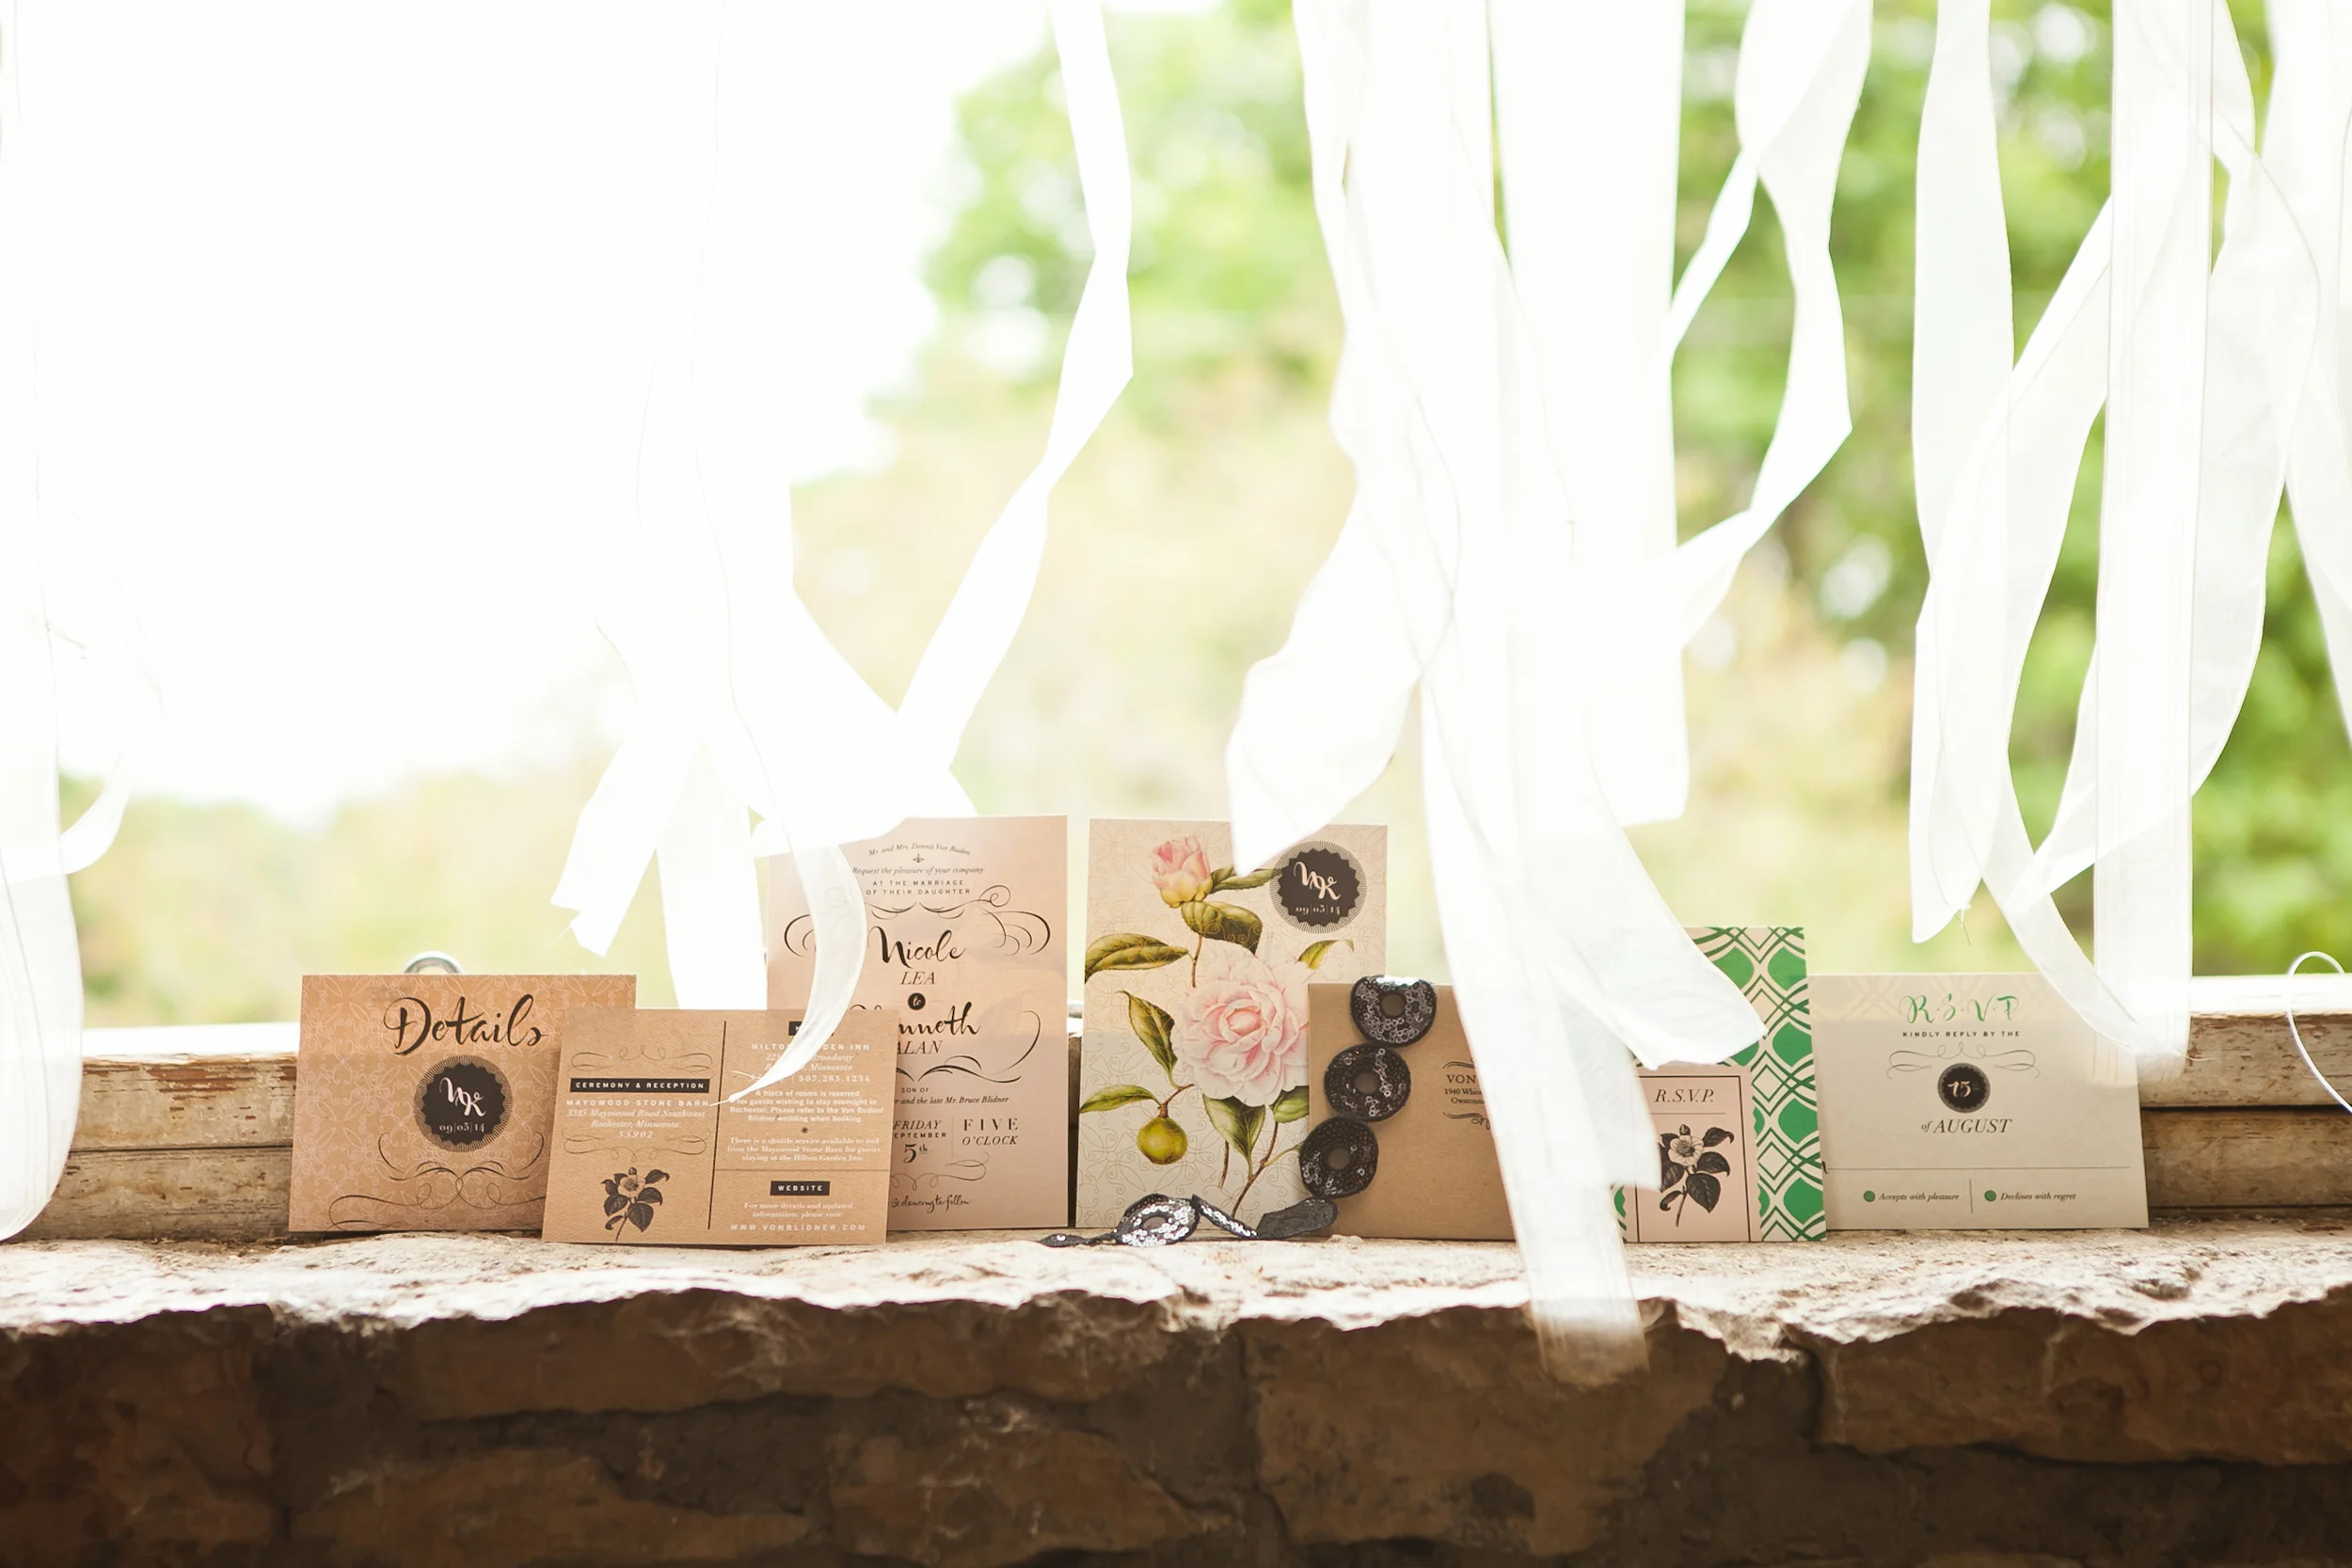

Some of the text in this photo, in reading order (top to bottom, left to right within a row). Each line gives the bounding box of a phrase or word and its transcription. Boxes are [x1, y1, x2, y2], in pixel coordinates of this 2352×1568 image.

[853, 867, 984, 875] Request the pleasure of your company
[867, 926, 966, 969] Nicole
[900, 972, 936, 985] LEA
[898, 1002, 981, 1035] nneth
[383, 994, 549, 1055] Details
[1446, 1074, 1476, 1084] VON
[1654, 1089, 1714, 1103] R.S.V.P.
[589, 1110, 635, 1119] Mayowood
[893, 1120, 941, 1129] FRIDAY
[964, 1118, 1018, 1131] FIVE
[1921, 1118, 2012, 1133] of AUGUST
[962, 1136, 1018, 1146] O'CLOCK
[1879, 1192, 1959, 1202] Accepts with pleasure
[2000, 1192, 2076, 1202] Declines with regret
